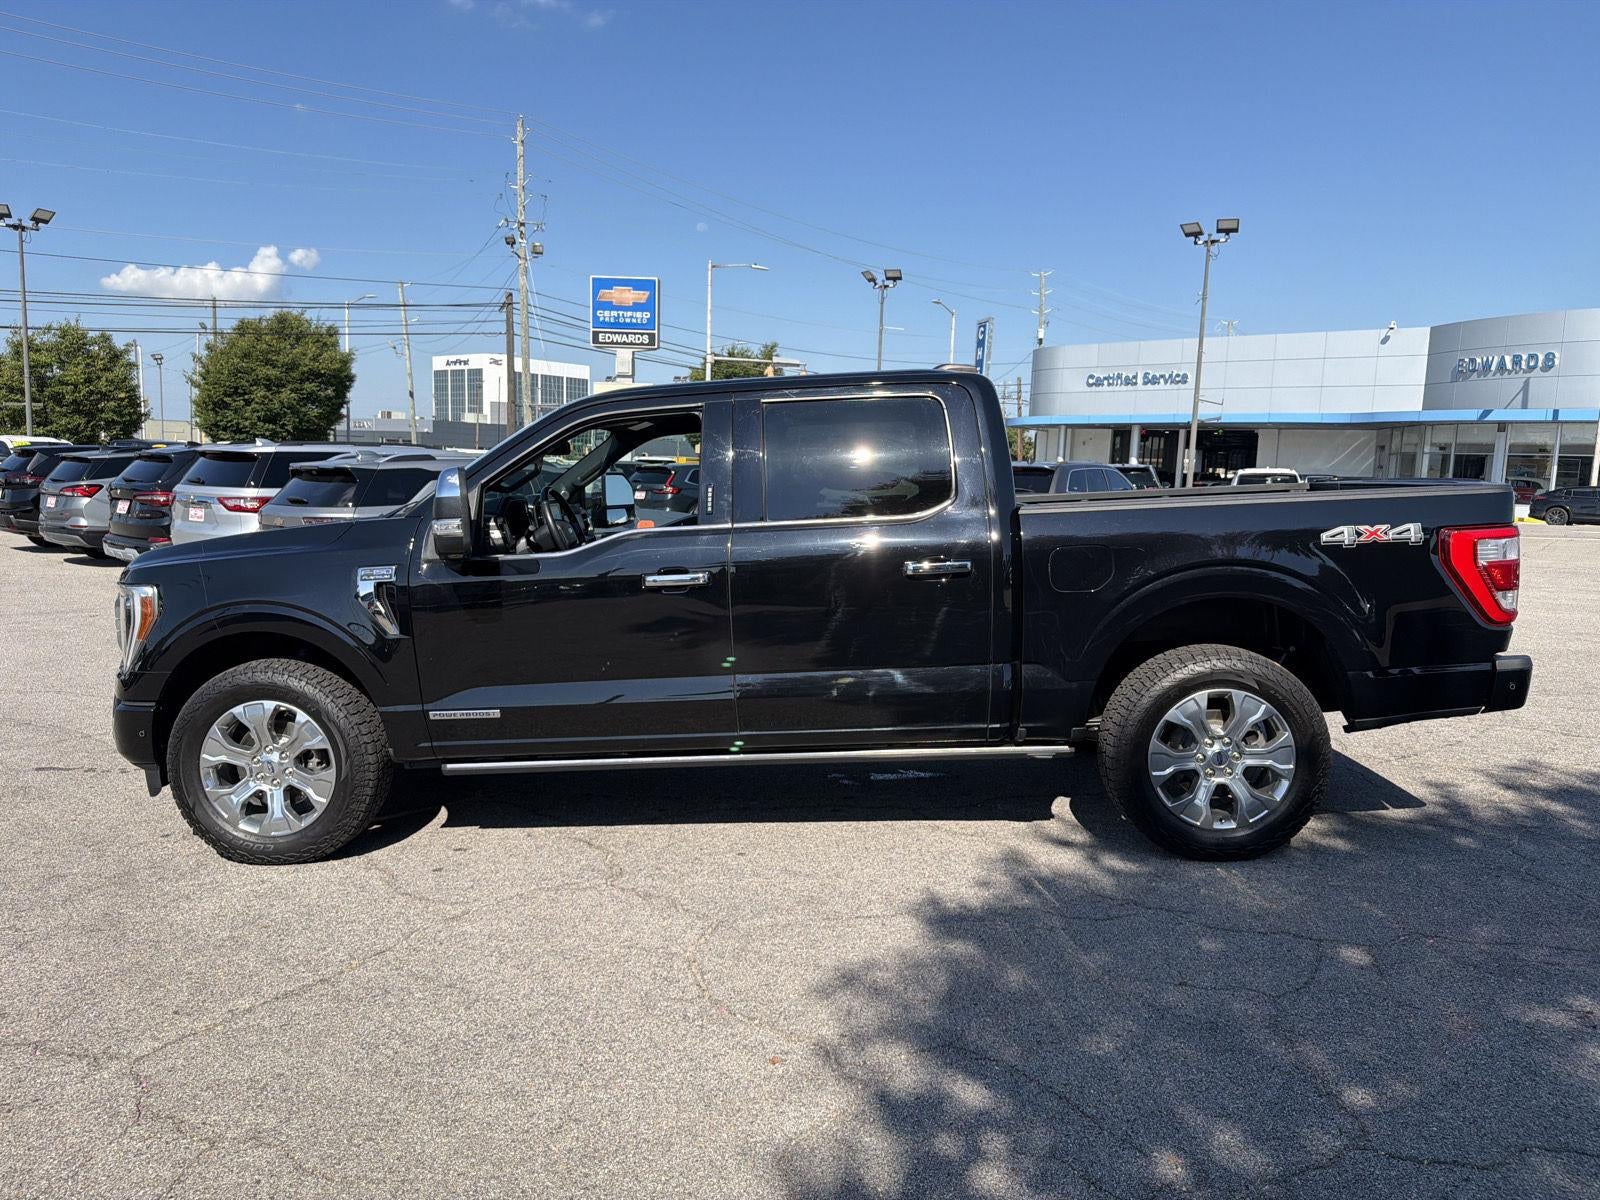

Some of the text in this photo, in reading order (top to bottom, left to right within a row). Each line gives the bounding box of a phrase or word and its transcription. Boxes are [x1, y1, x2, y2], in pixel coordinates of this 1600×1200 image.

[596, 310, 651, 319] CERTIFIED
[599, 316, 648, 324] PRE-OWNED
[598, 333, 650, 344] EDWARDS
[1456, 352, 1558, 373] EDWARDS
[1085, 370, 1190, 388] Certified Service
